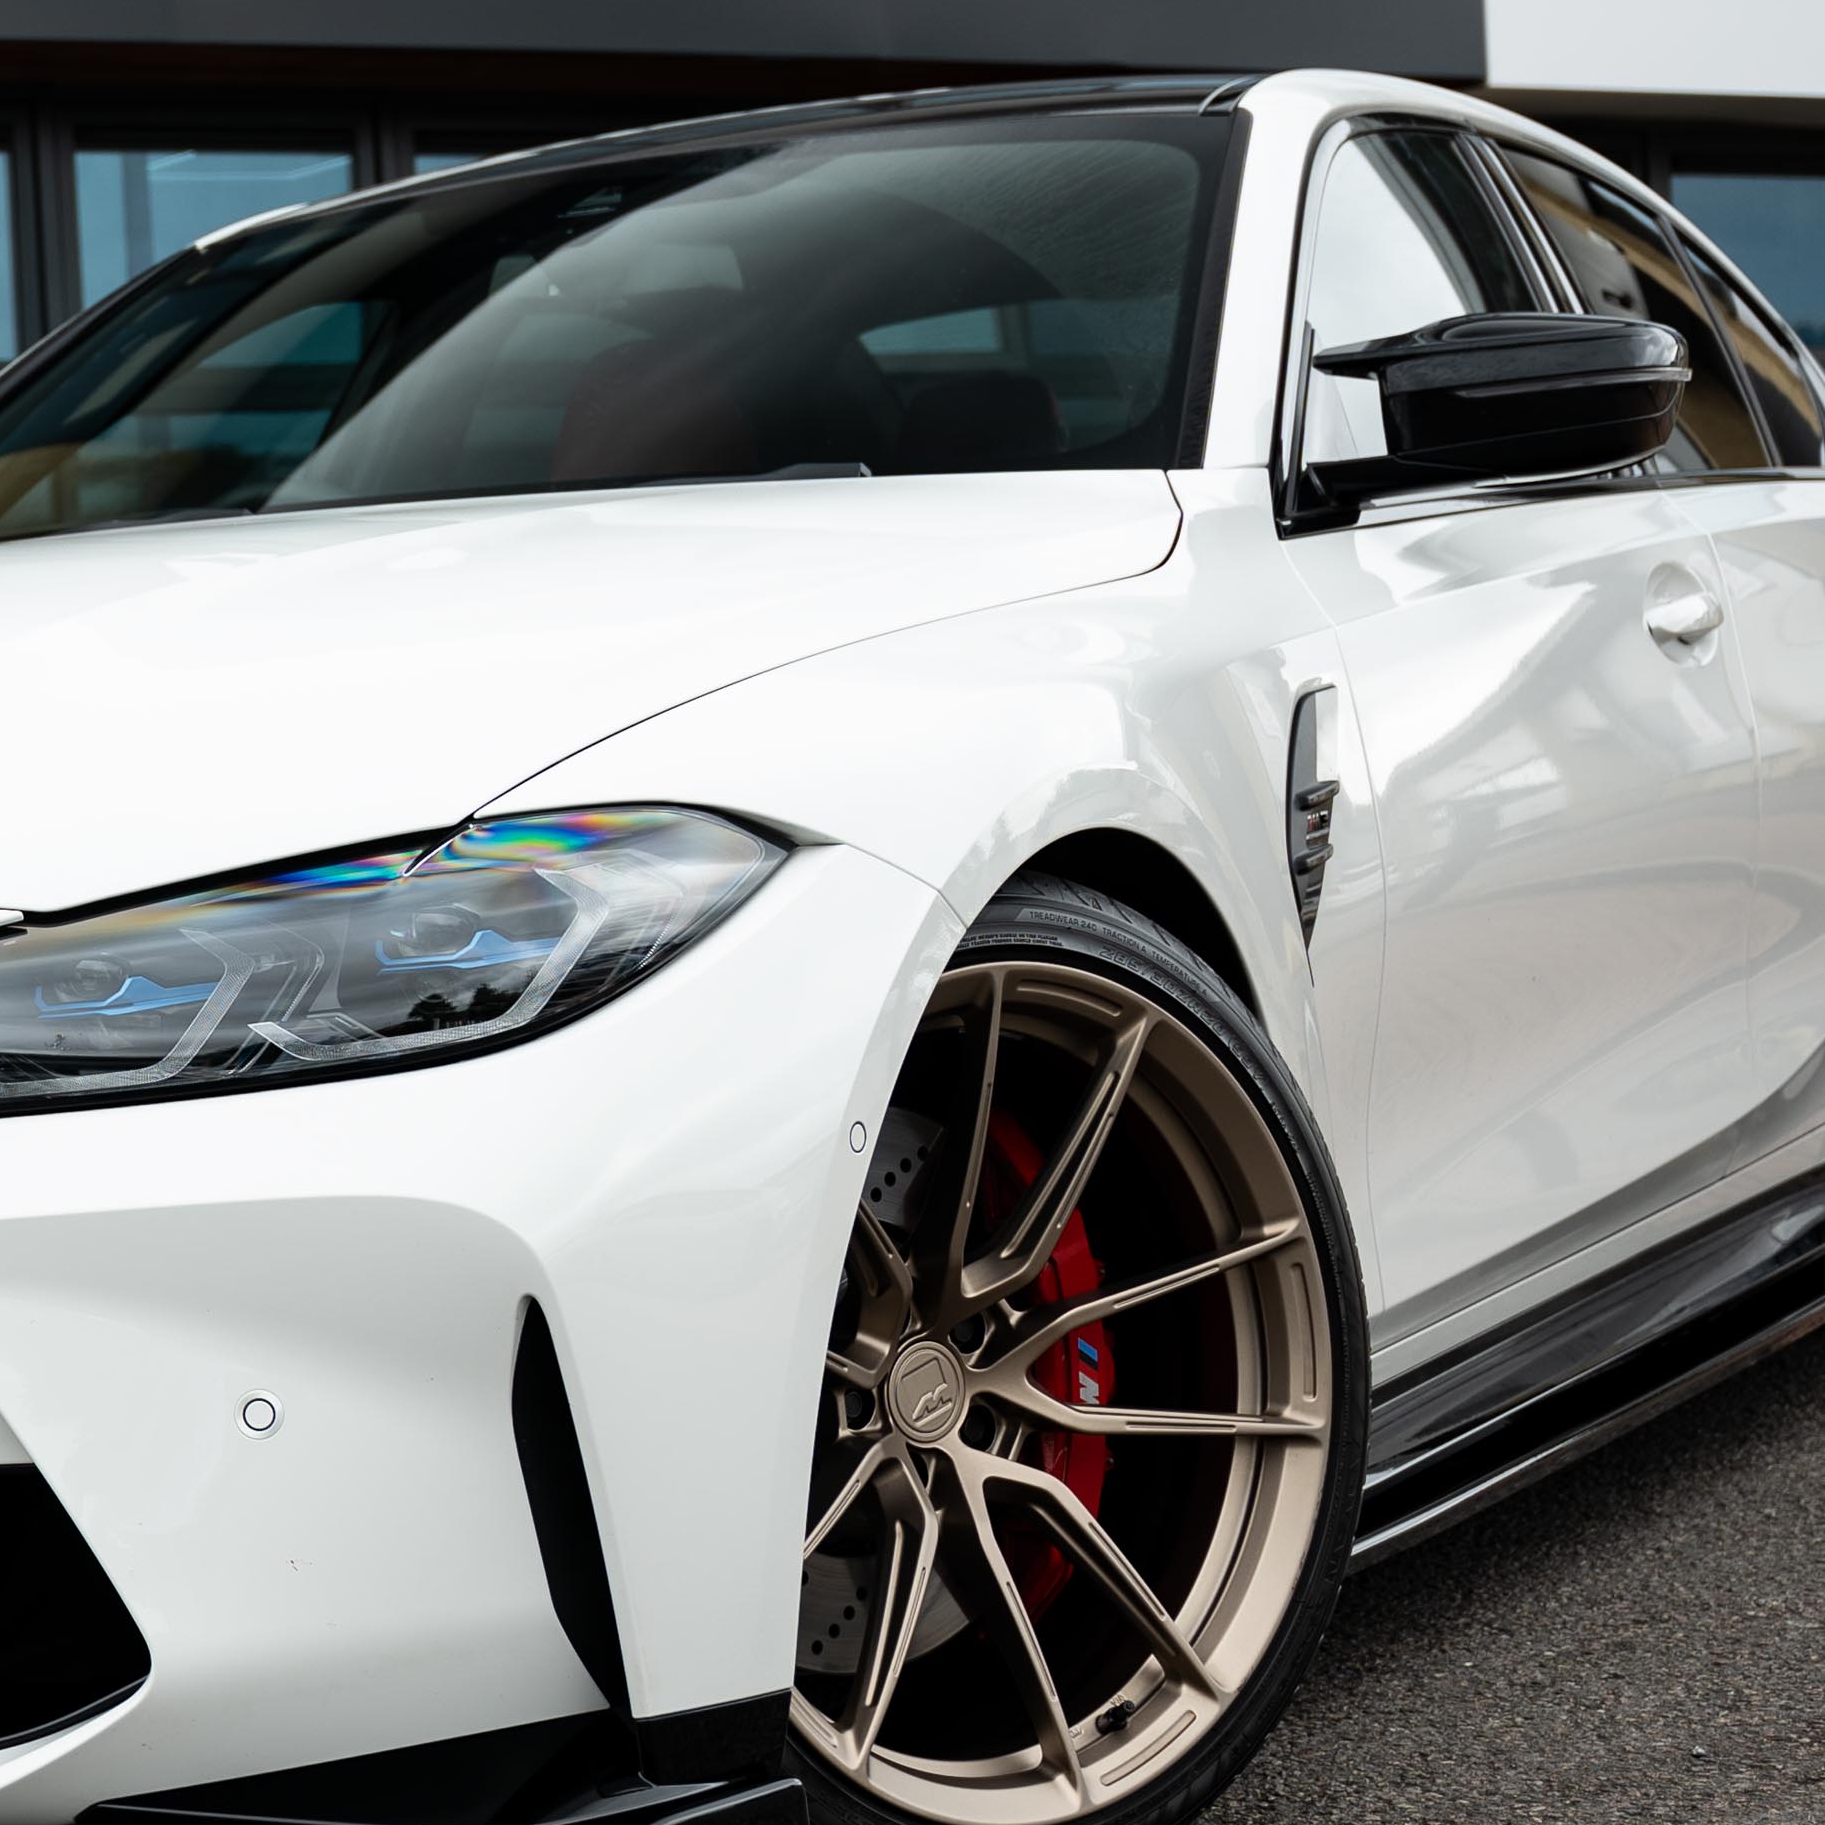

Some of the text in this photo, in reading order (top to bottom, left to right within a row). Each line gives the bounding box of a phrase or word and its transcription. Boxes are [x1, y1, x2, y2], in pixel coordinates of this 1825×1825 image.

[1029, 911, 1080, 927] TREADWEAR
[1080, 921, 1098, 932] 240
[1102, 927, 1140, 950] TRACTION
[1152, 951, 1201, 991] TEMPERATURE
